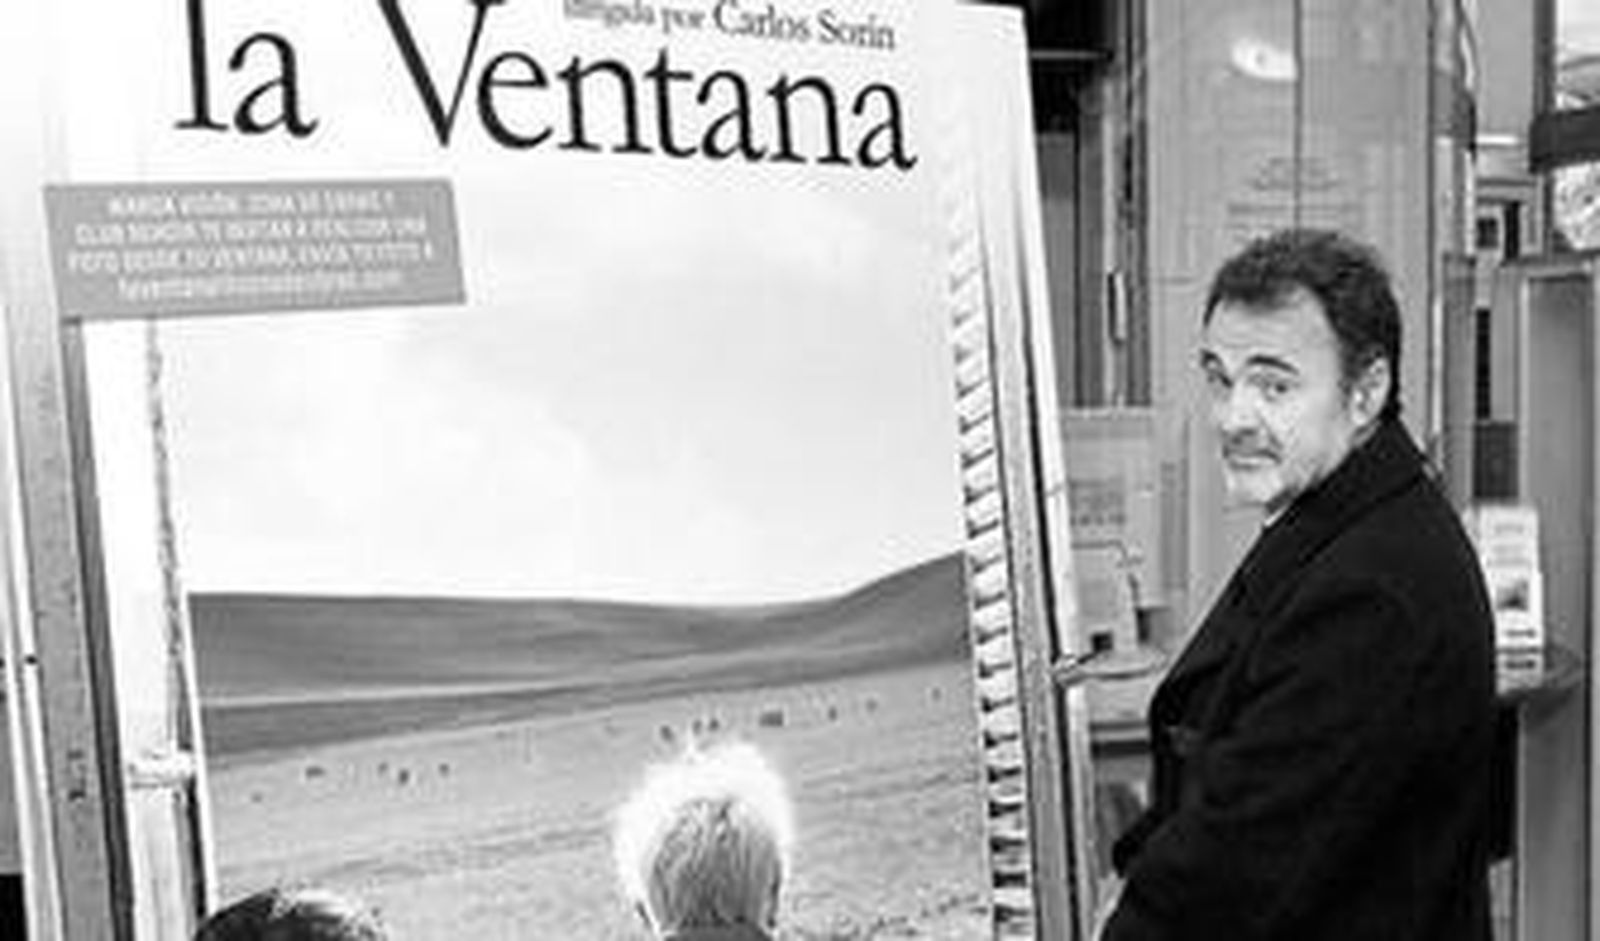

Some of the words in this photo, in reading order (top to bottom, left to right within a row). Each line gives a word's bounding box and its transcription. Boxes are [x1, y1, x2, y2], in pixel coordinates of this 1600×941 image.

[660, 8, 706, 35] por
[712, 0, 812, 42] Carlos
[173, 0, 319, 138] la
[376, 0, 918, 170] Ventana
